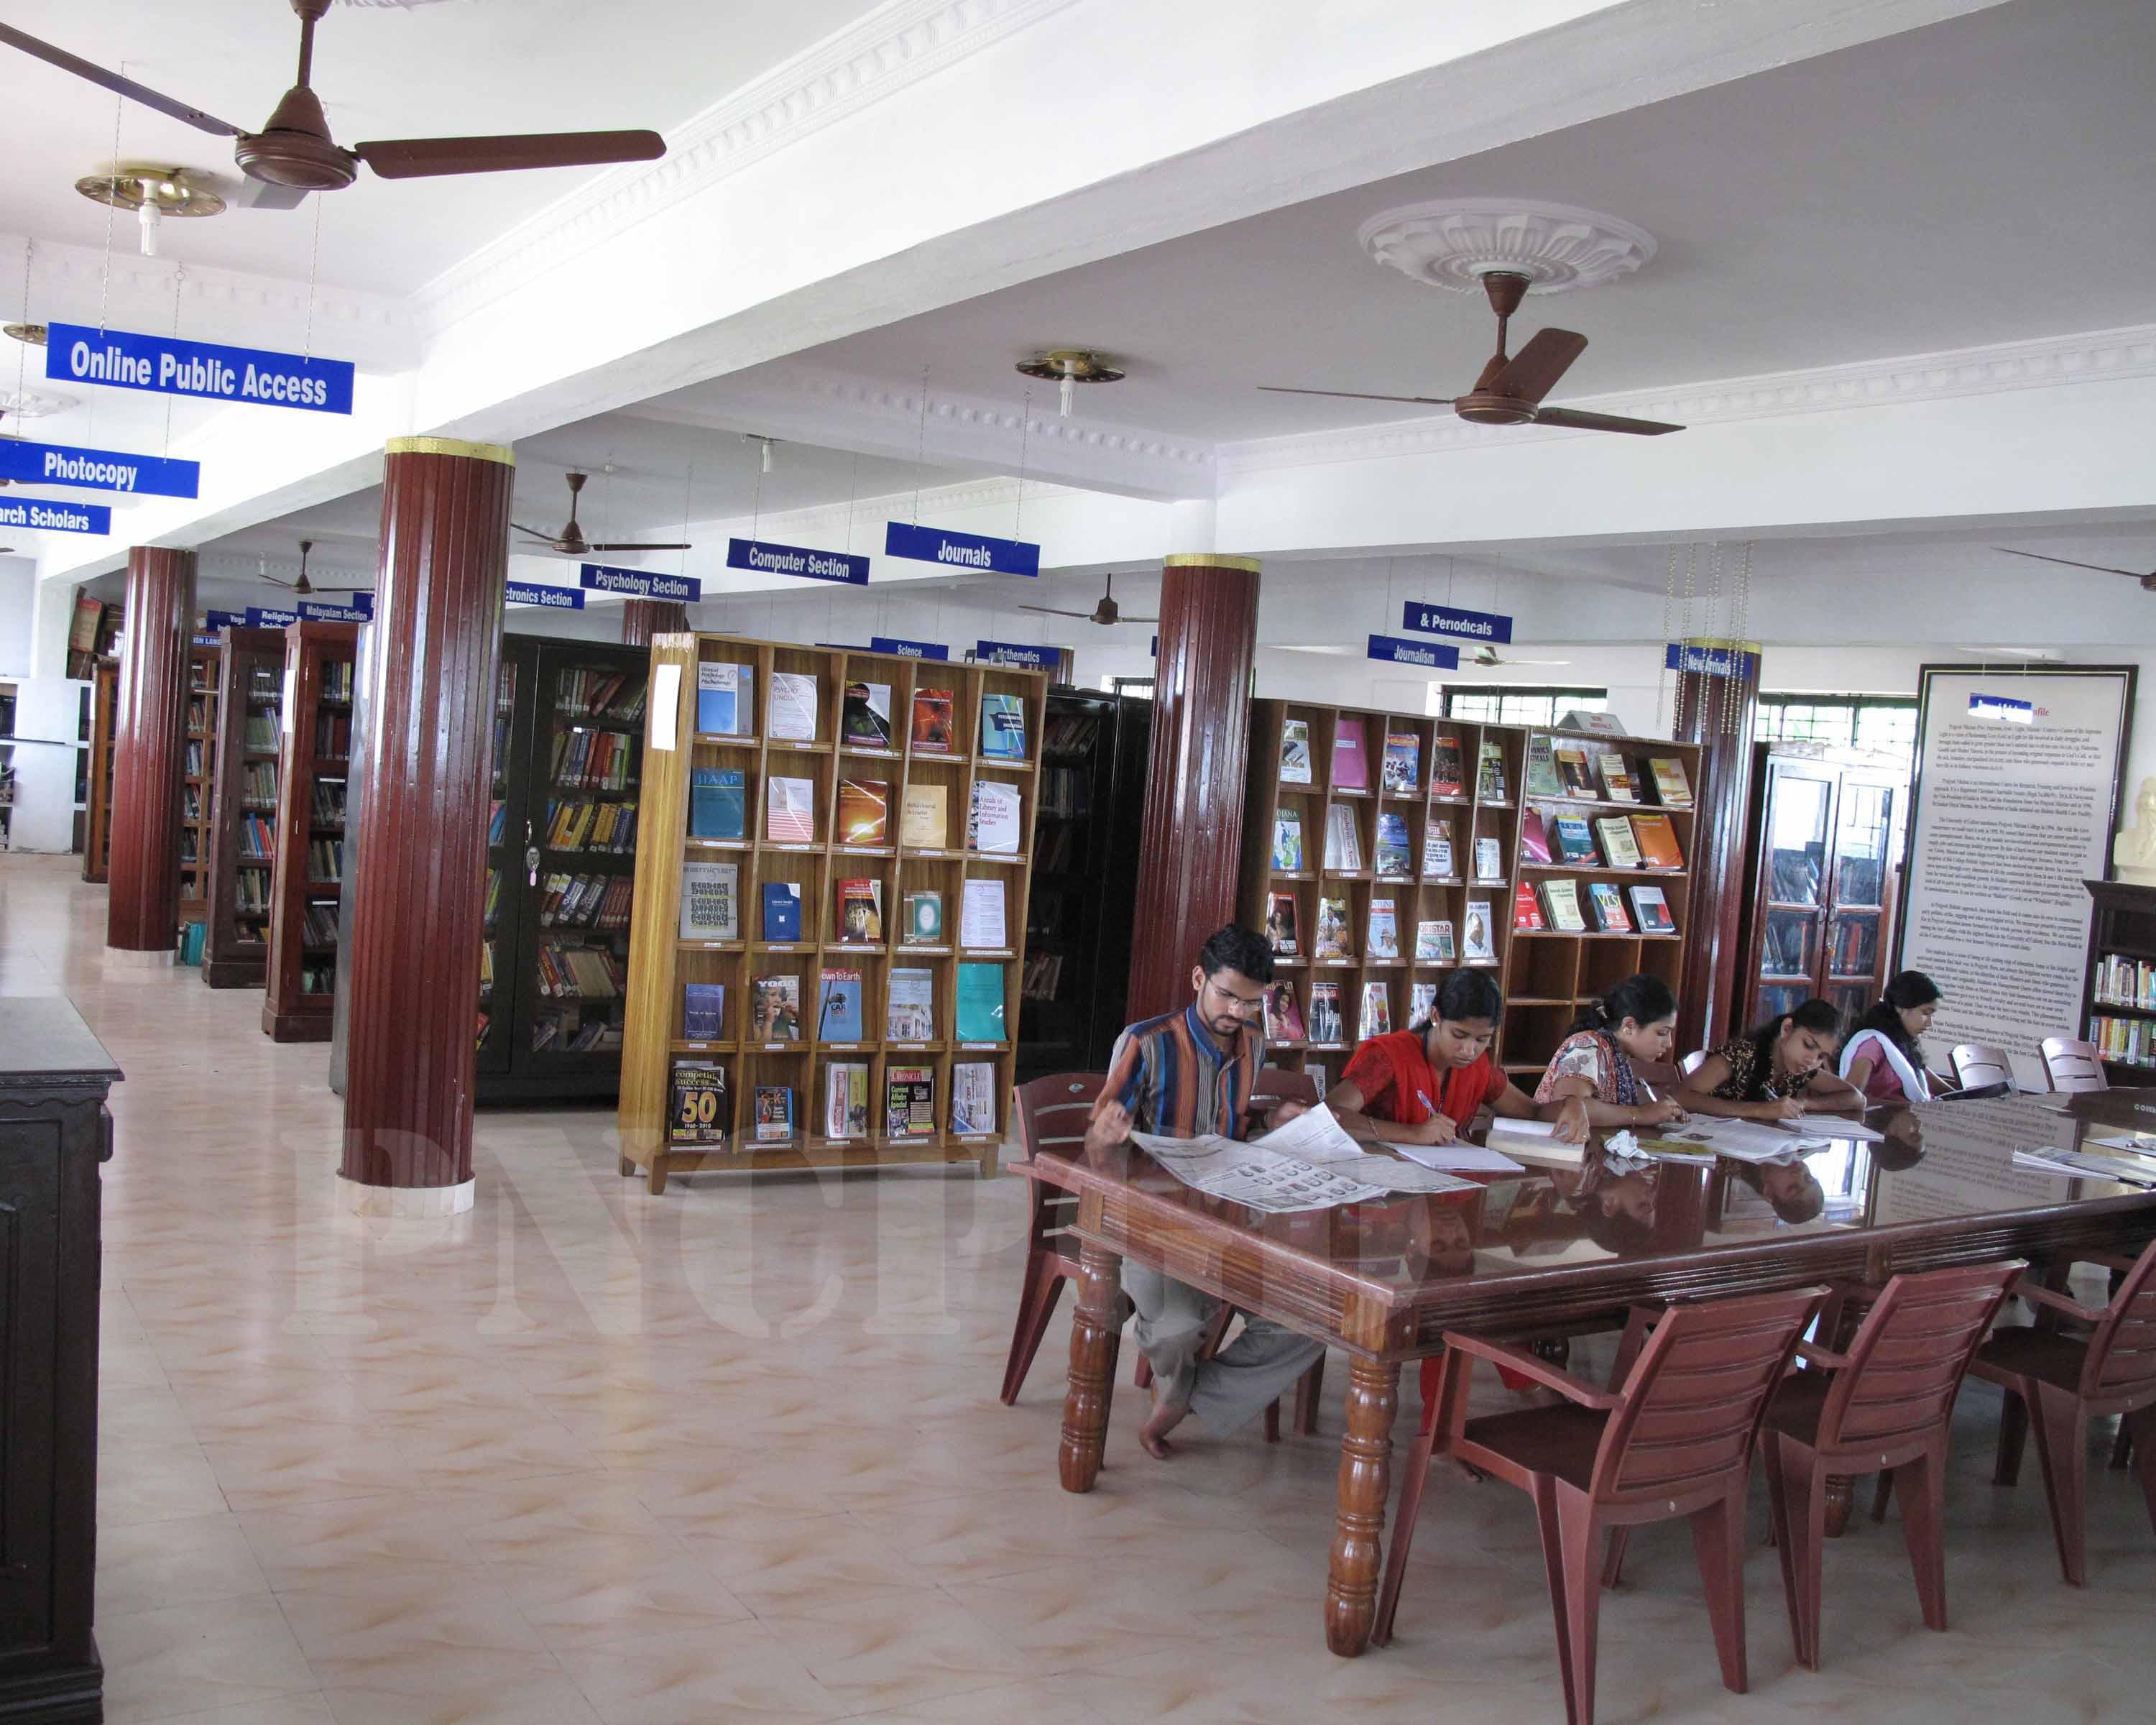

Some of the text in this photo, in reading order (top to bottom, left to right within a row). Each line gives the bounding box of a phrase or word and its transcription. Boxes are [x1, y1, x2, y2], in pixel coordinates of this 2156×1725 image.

[72, 341, 328, 405] Online Public Access
[45, 452, 137, 491] Photocopy
[0, 505, 89, 530] arch Scholars
[749, 546, 849, 578] Computer Section
[937, 540, 992, 567] Journals
[596, 570, 688, 596] Psychology Section
[506, 589, 573, 607] ctronics Section
[230, 615, 245, 625] Yoga
[262, 611, 294, 622] Religion
[307, 605, 368, 622] Malayalam Section
[1420, 613, 1492, 636] & Periodicals
[205, 636, 221, 645] LANG
[897, 644, 922, 658] Science
[998, 647, 1040, 663] Mathematics
[1394, 645, 1435, 665] Journalism
[1687, 654, 1731, 675] New Arrivals
[980, 803, 996, 812] Library
[682, 1092, 717, 1123] 50
